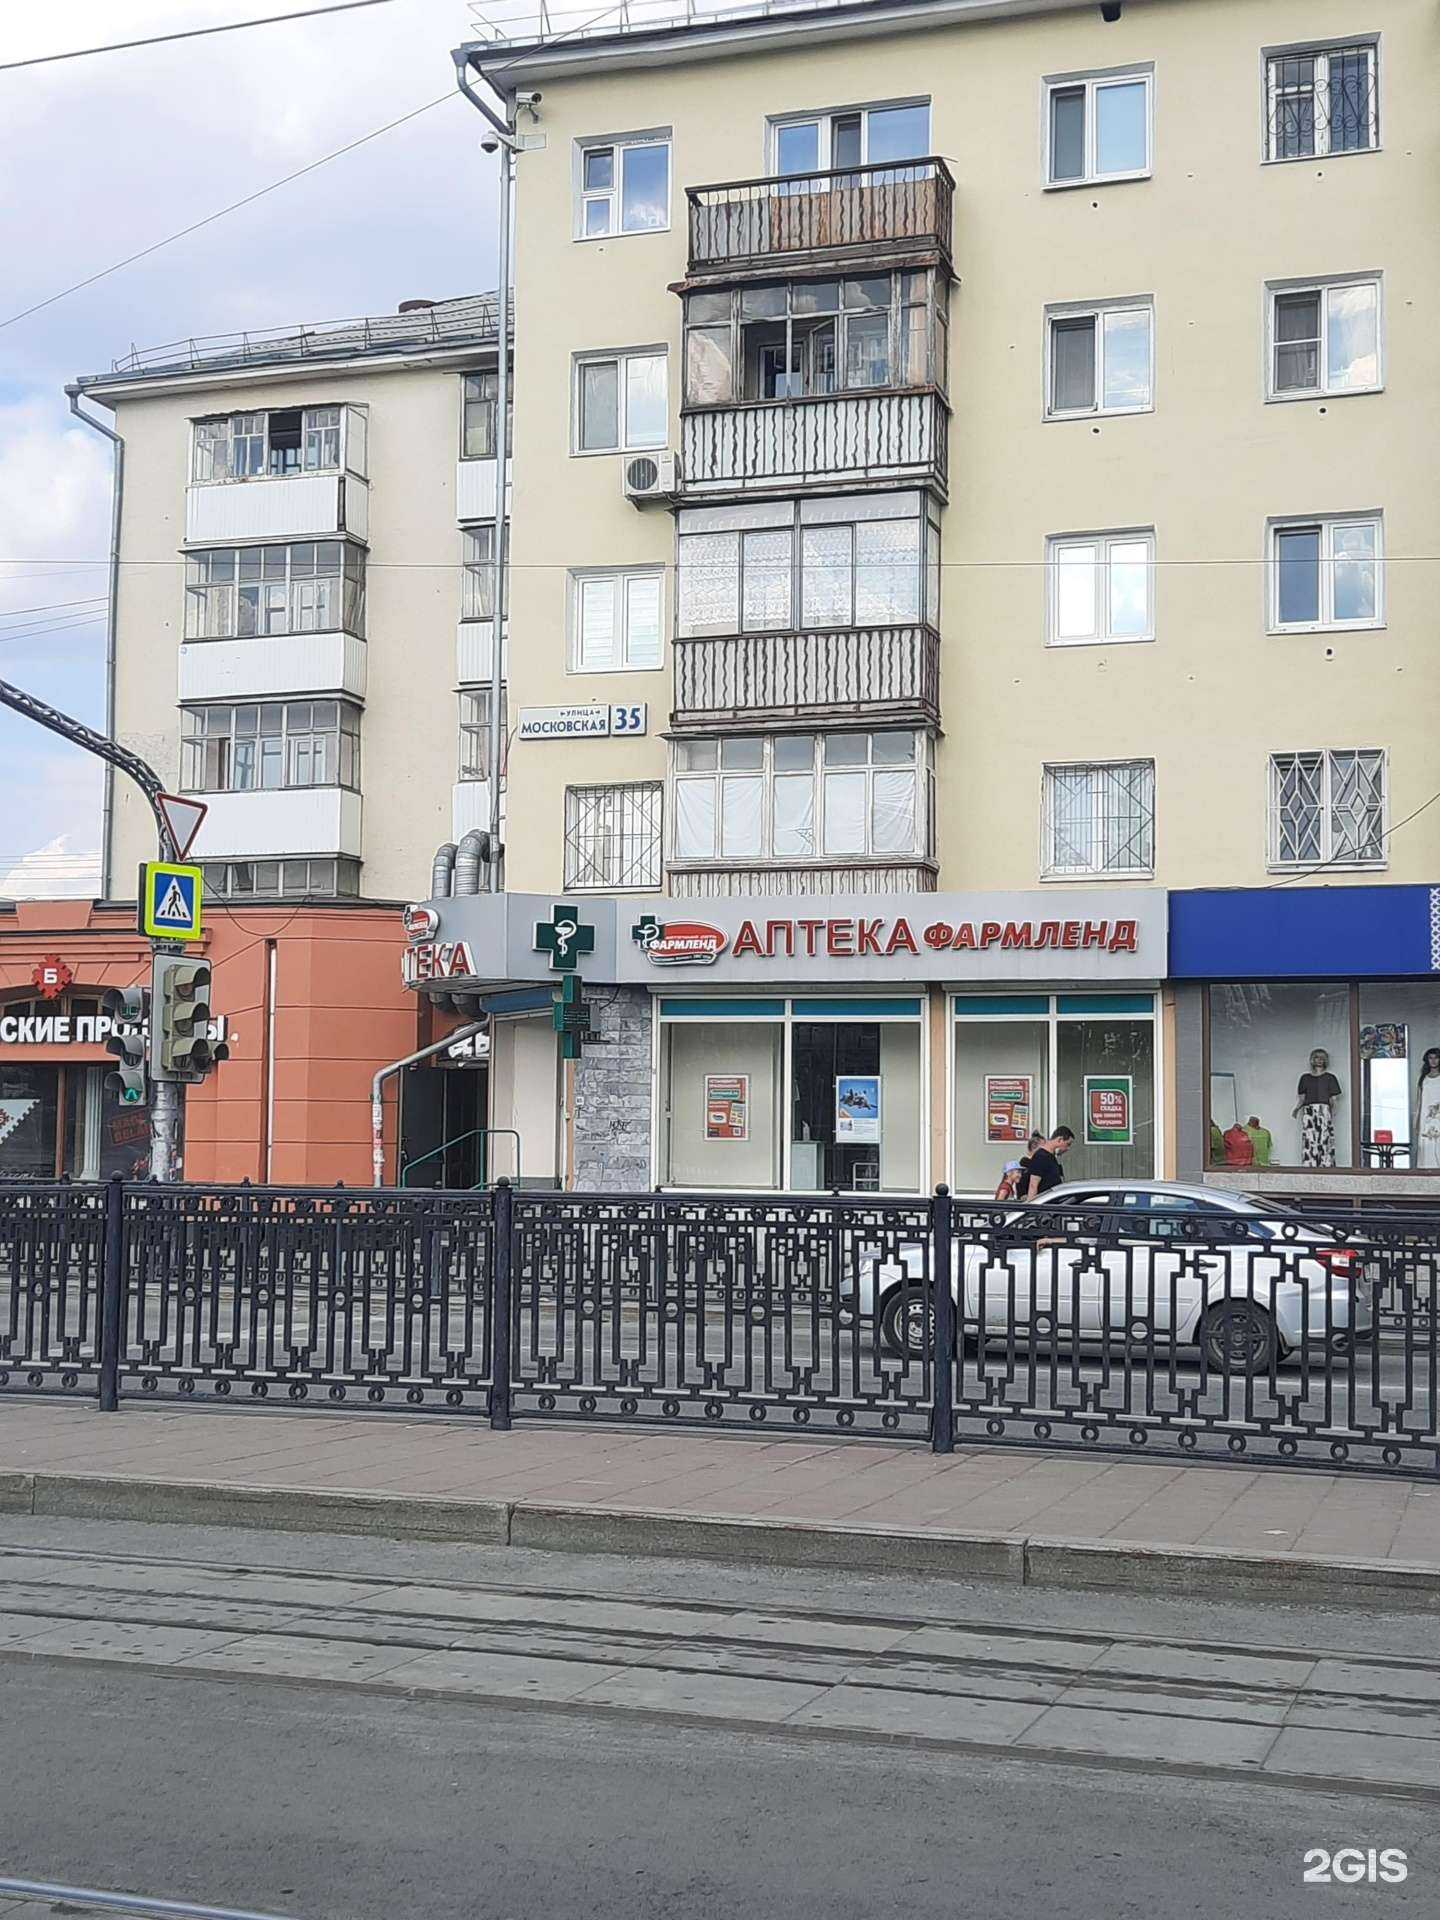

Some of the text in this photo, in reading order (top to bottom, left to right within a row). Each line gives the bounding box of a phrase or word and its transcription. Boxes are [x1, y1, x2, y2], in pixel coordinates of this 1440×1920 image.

[566, 709, 594, 717] УЛИЦА
[614, 707, 641, 730] 35
[521, 719, 606, 734] МОСКОВСКАЯ
[649, 938, 717, 951] ФАРМЛЕНД
[731, 918, 1140, 956] АПТЕКА ФАРМЛЕНД
[43, 968, 58, 984] Б
[0, 1015, 70, 1043] СКИЕ
[1100, 1092, 1122, 1105] 50%
